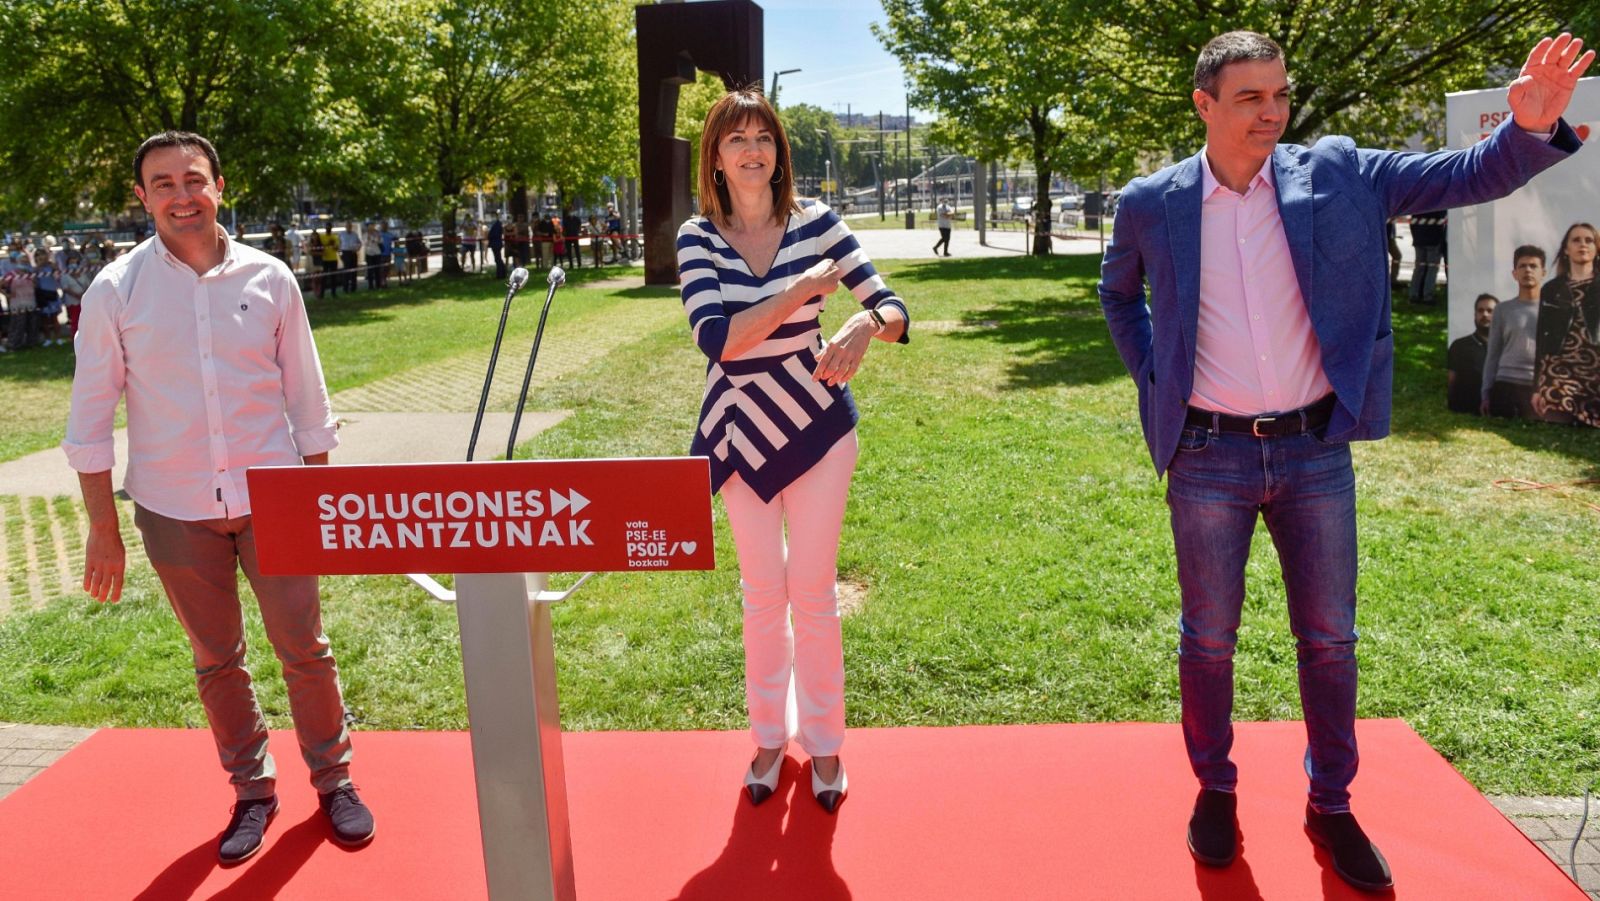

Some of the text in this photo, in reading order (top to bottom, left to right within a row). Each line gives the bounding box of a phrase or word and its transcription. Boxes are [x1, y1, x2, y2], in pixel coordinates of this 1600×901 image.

[317, 489, 545, 521] SOLUCIONES
[626, 520, 648, 529] vota
[320, 519, 594, 550] ERANTZUNAK
[626, 529, 667, 541] PSE-EE
[628, 558, 669, 567] bozkatu
